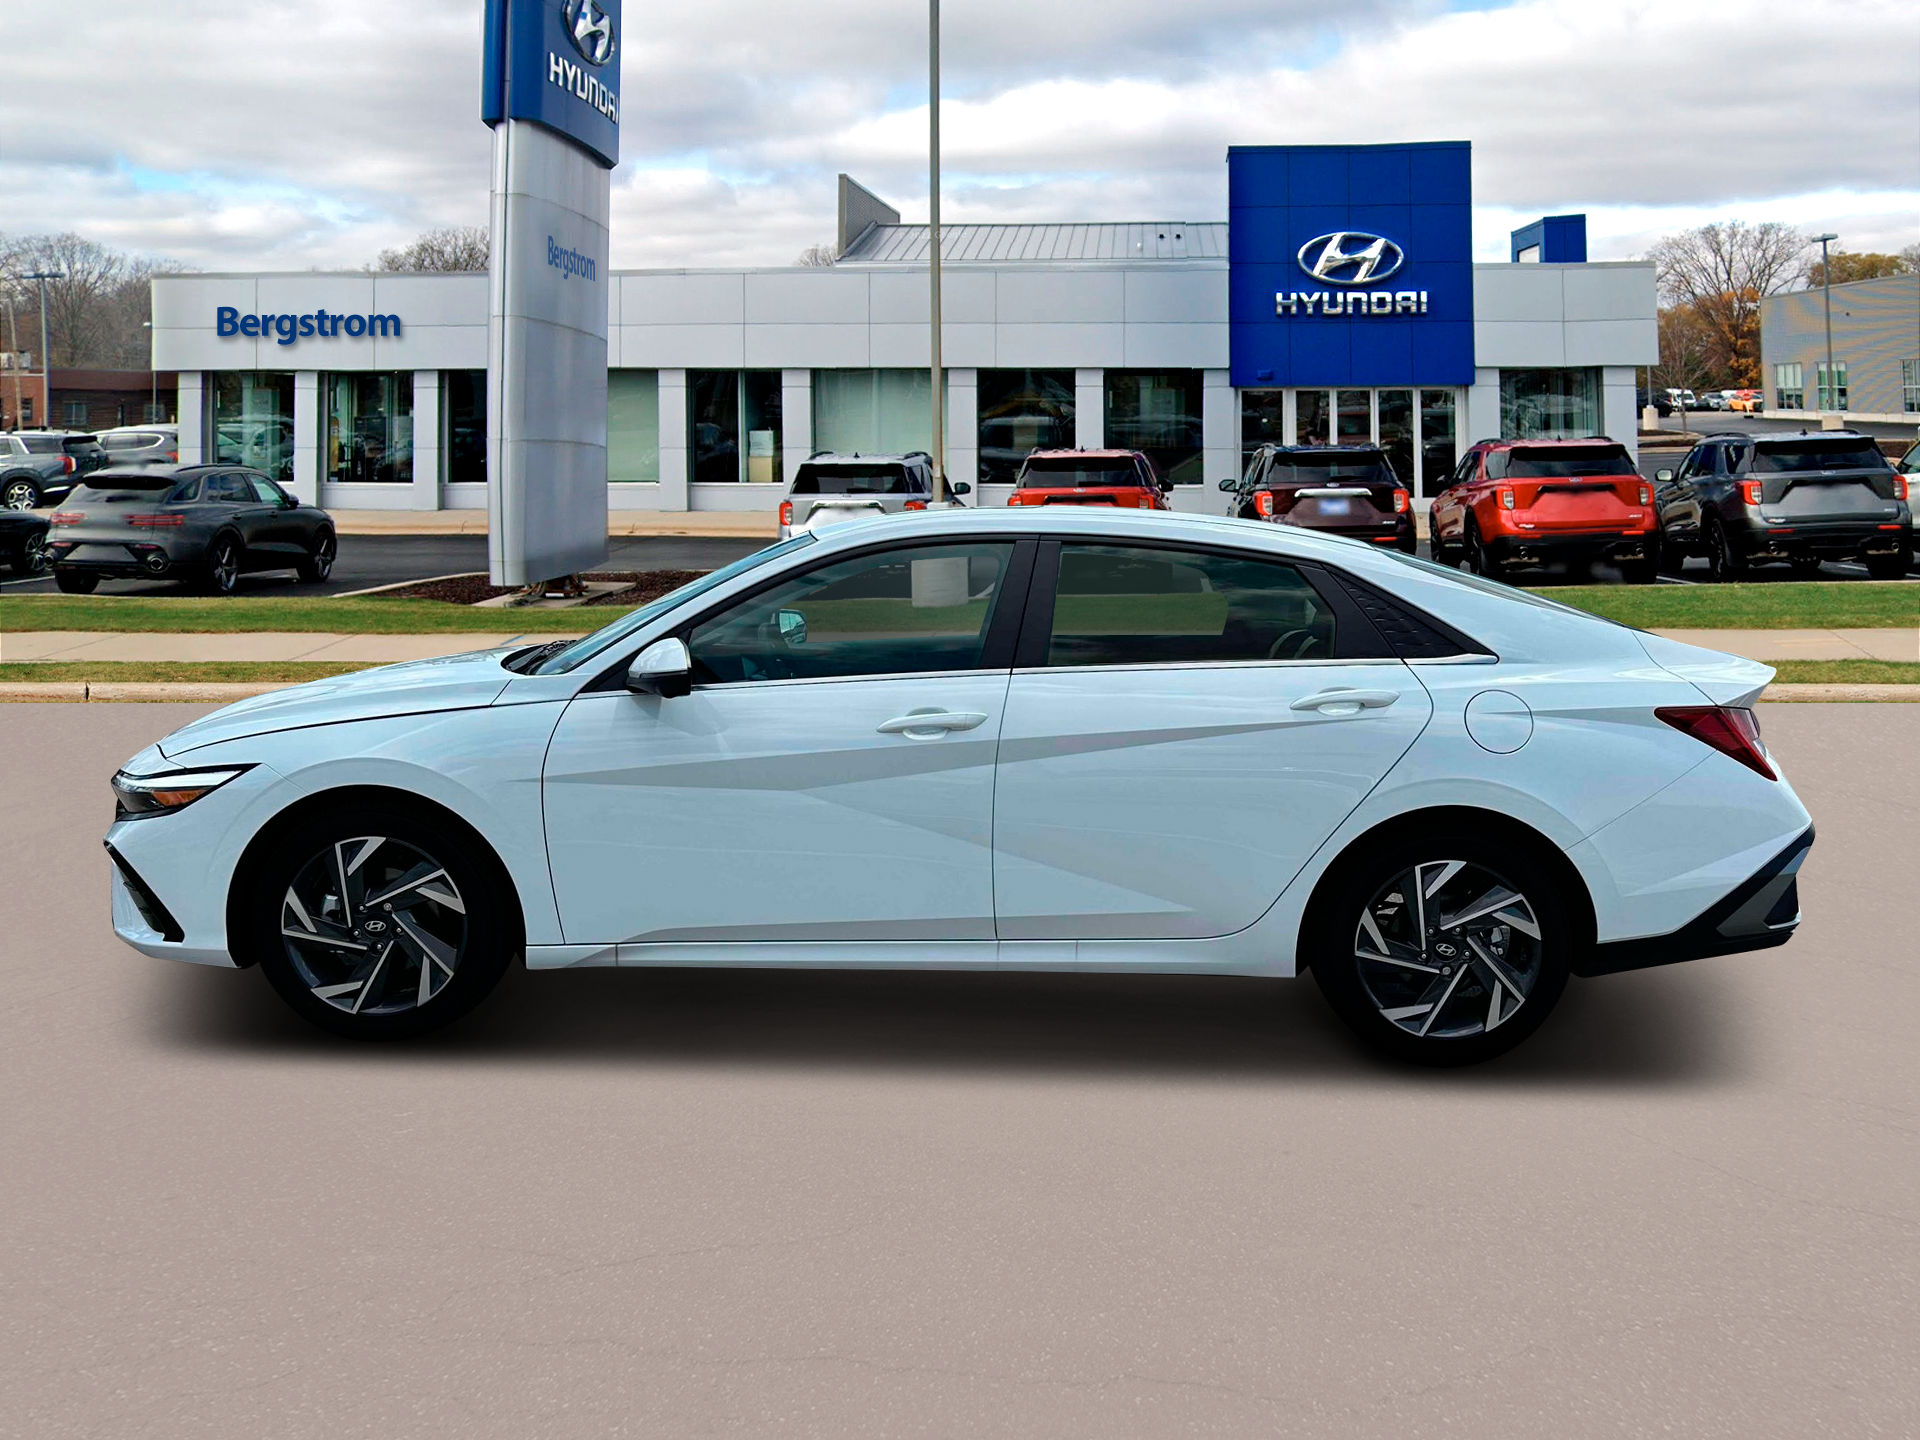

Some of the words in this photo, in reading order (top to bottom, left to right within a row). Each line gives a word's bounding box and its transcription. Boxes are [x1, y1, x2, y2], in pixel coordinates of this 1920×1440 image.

[549, 51, 619, 124] HYUNDAI
[547, 234, 596, 282] Bergstrom
[1275, 290, 1428, 315] HYUNDAI
[216, 306, 402, 346] Bergstrom
